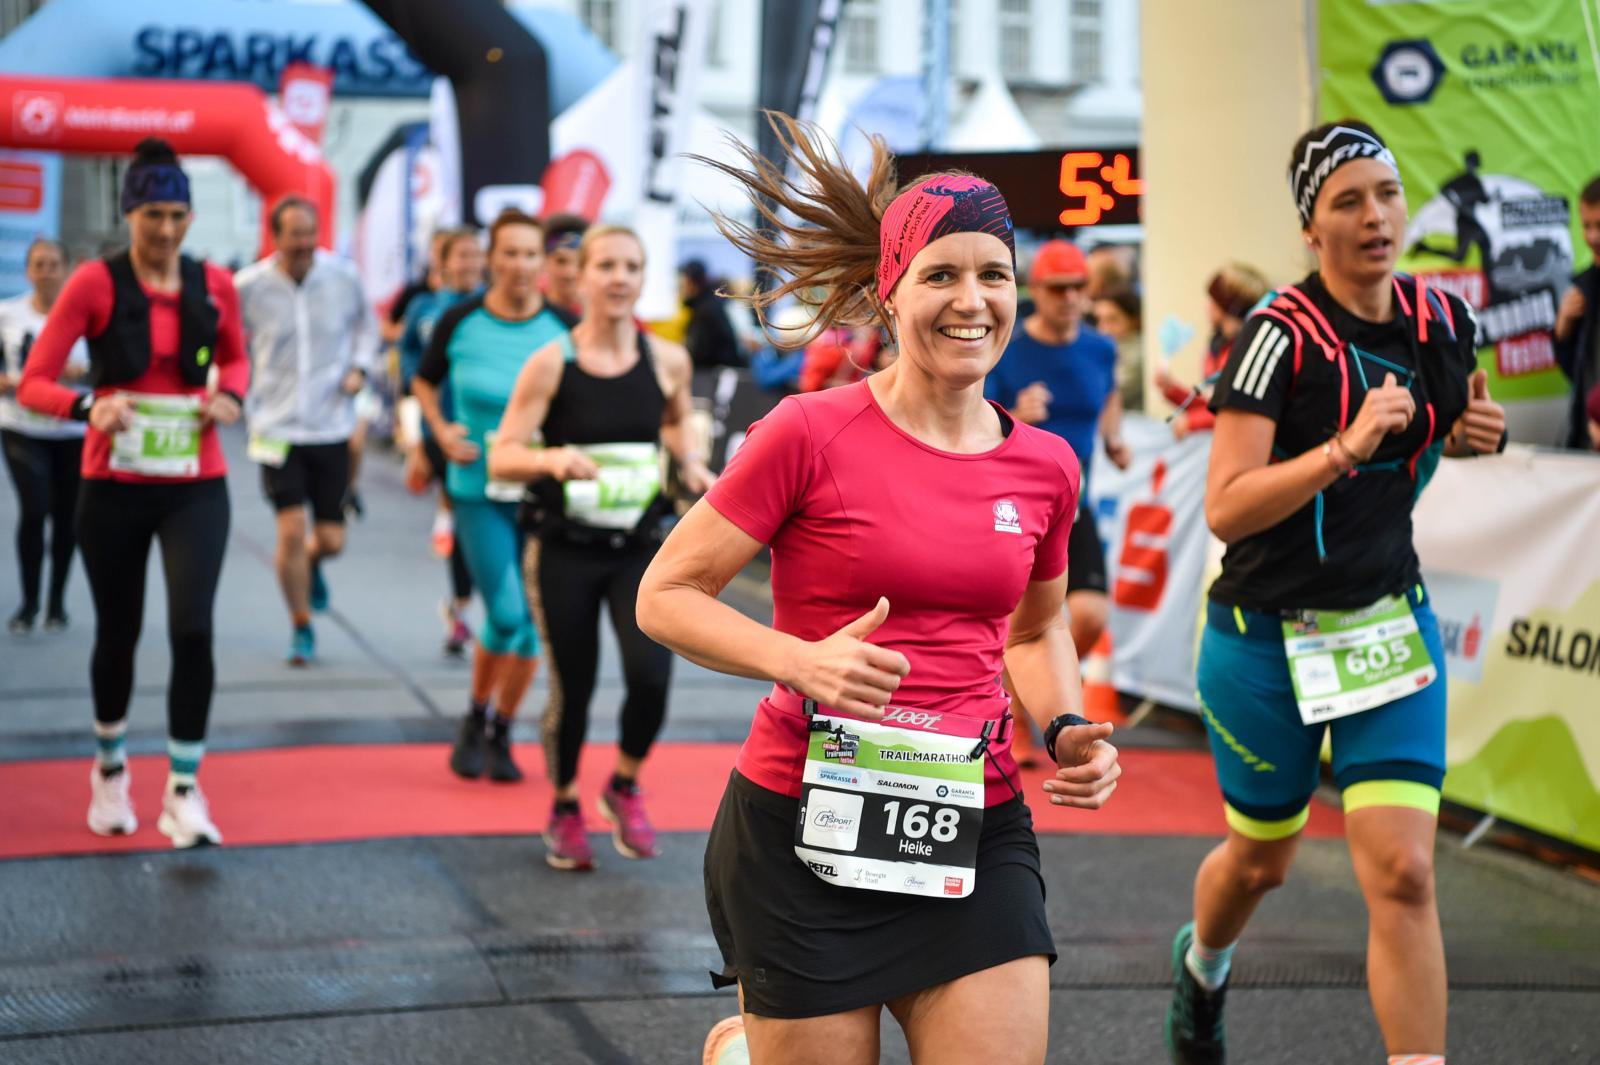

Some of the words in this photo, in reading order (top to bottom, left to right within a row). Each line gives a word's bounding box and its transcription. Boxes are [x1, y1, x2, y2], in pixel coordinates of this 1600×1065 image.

[1300, 142, 1380, 220] YNAFIT
[900, 195, 924, 243] VIKING
[1346, 639, 1412, 675] 605
[879, 750, 973, 764] TRAILMARATHON
[819, 773, 852, 783] SPARKASSE
[877, 779, 919, 791] SALOMON
[883, 800, 961, 843] 168
[899, 839, 933, 857] Heike
[807, 860, 838, 877] PETZL
